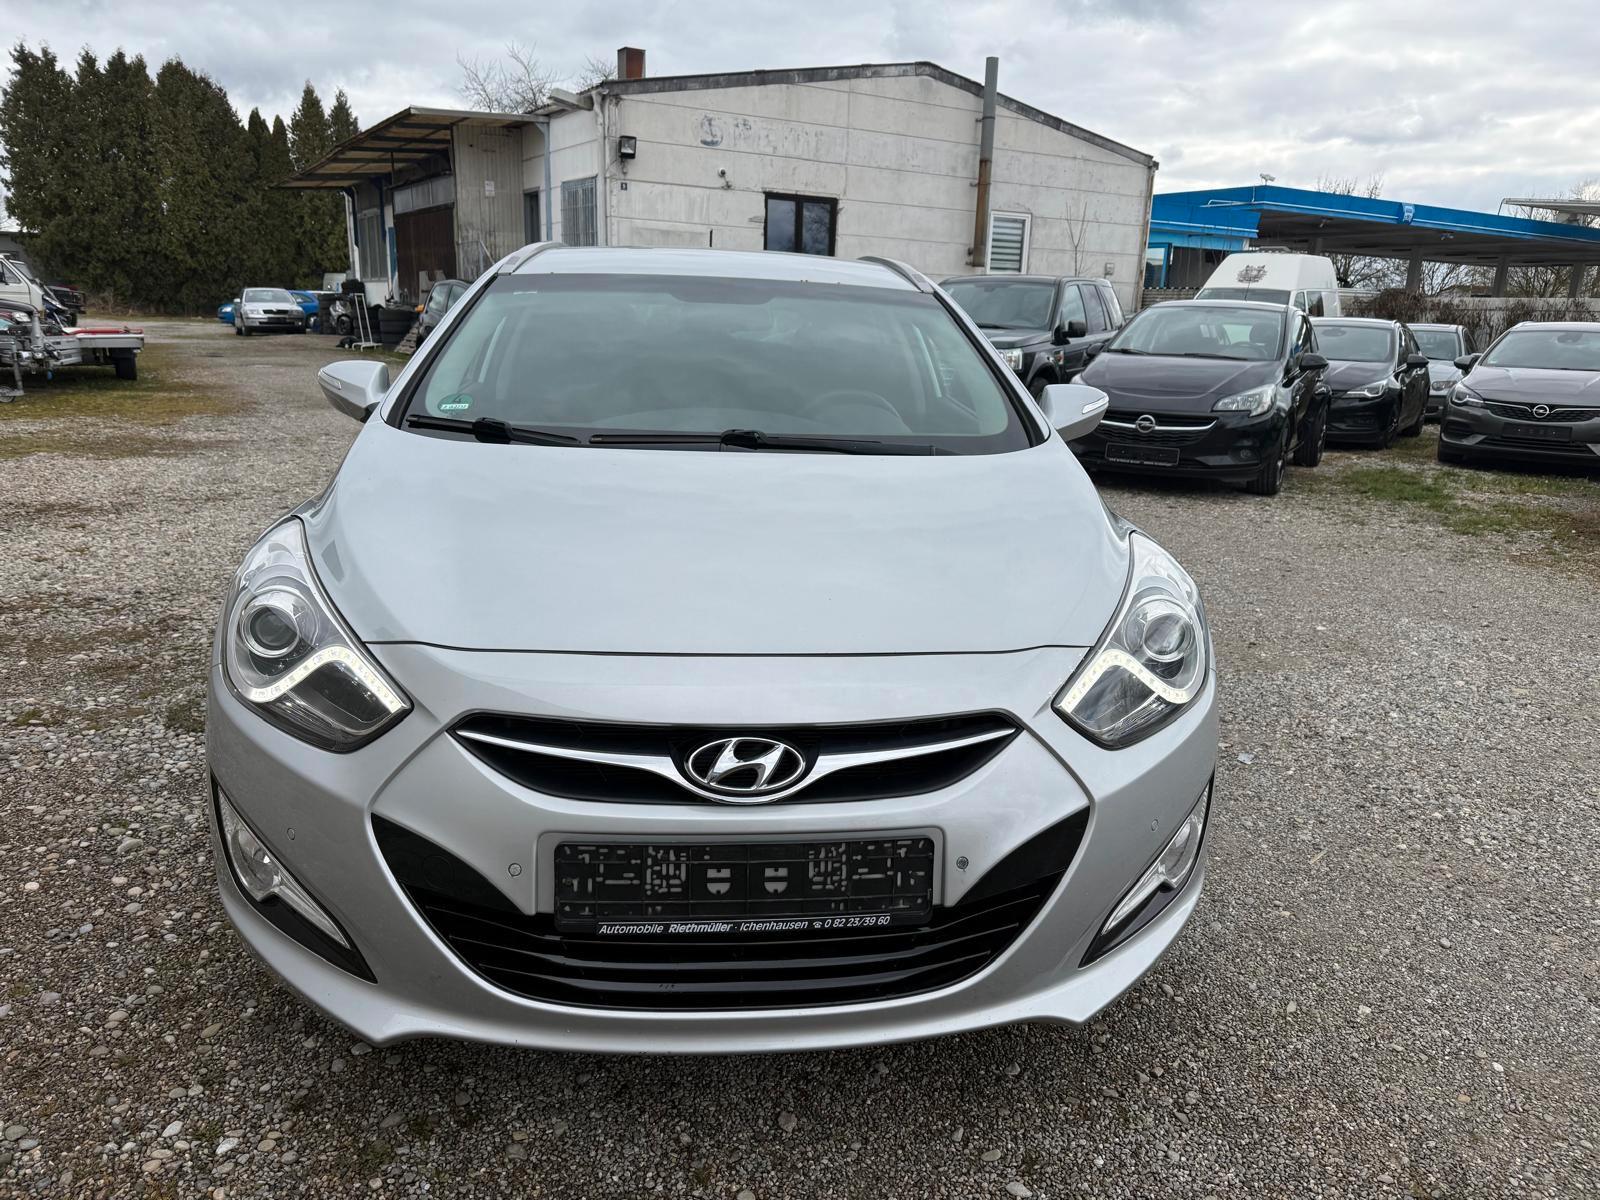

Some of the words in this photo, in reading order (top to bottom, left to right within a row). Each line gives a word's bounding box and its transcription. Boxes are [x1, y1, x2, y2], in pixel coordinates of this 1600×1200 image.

[598, 924, 664, 934] Automobile
[668, 922, 733, 933] Riethmüller
[739, 920, 808, 931] Ichenhausen
[824, 918, 832, 928] 0
[832, 918, 846, 928] 82
[846, 916, 876, 927] 23/39
[877, 915, 891, 925] 60
